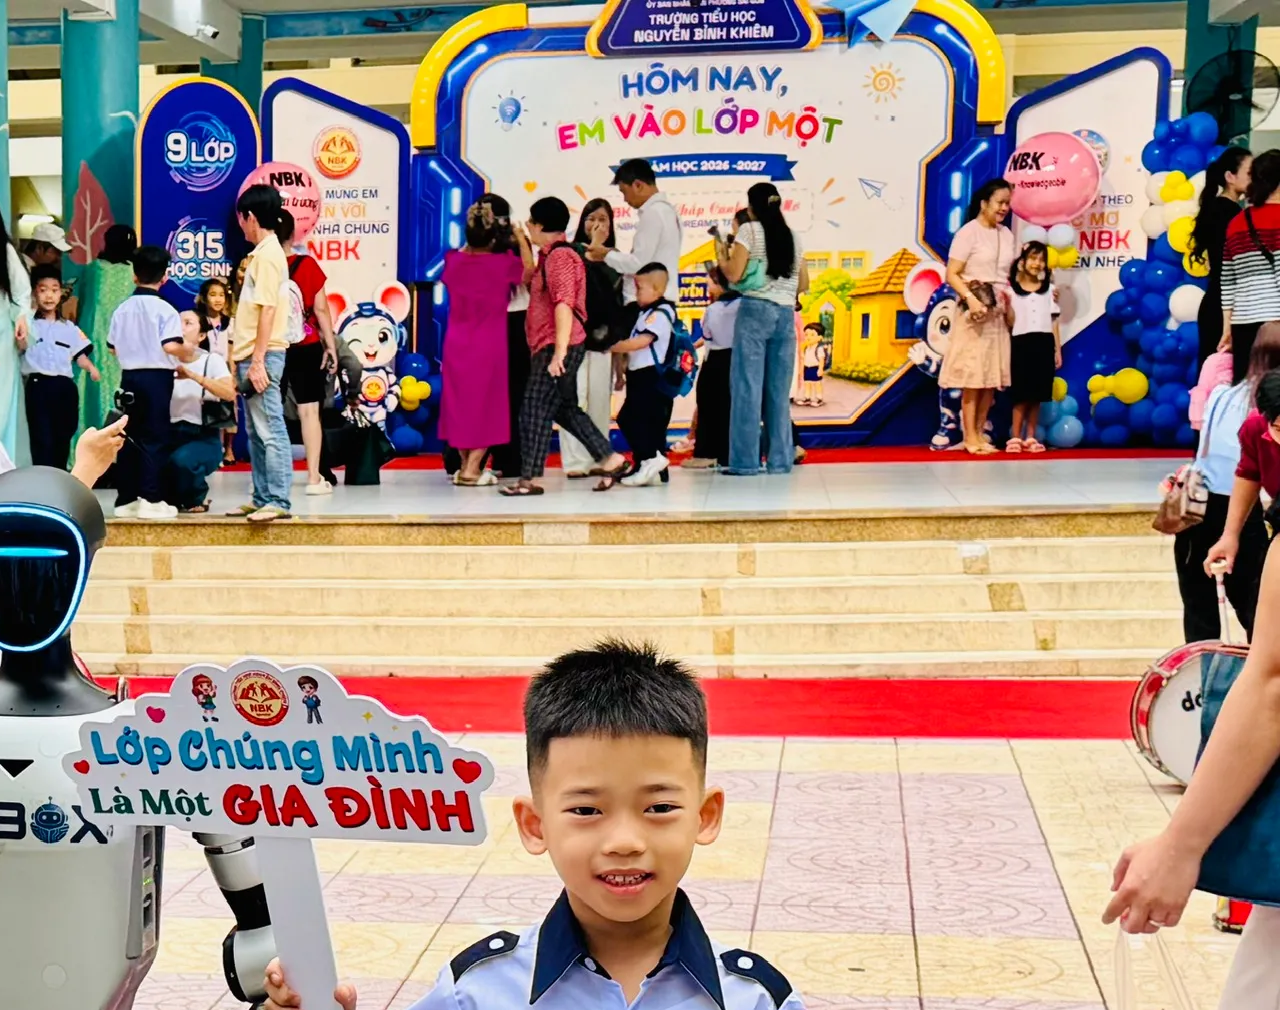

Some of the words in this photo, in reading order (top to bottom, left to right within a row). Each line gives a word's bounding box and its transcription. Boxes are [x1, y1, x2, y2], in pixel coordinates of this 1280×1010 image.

[649, 11, 699, 25] TRƯỜNG
[701, 8, 728, 23] TIỂU
[730, 10, 756, 24] HỌC
[634, 24, 690, 43] NGUYỄN
[730, 24, 774, 40] KHIÊM
[622, 62, 699, 98] HÔM
[708, 65, 788, 97] NAY,
[557, 118, 605, 150] EM
[613, 104, 686, 140] VÀO
[696, 97, 760, 135] LỚP
[766, 106, 843, 148] MỘT
[166, 132, 187, 162] 9
[191, 138, 234, 162] LỚP
[651, 160, 670, 172] ĂM
[672, 161, 699, 173] HỌC
[1008, 151, 1045, 172] NBK
[269, 172, 306, 187] NBK
[362, 189, 378, 199] EM
[1100, 194, 1134, 205] THEO
[344, 223, 390, 235] CHUNG
[176, 230, 224, 259] 315
[307, 240, 361, 261] NBK
[1079, 230, 1131, 252] NBK
[249, 704, 274, 713] NBK
[90, 726, 172, 775] Lớp
[179, 727, 324, 785] Chúng
[333, 732, 444, 774] Mình
[88, 786, 135, 815] Là
[139, 789, 213, 822] Một
[222, 784, 319, 829] GIA
[324, 776, 475, 833] ĐÌNH
